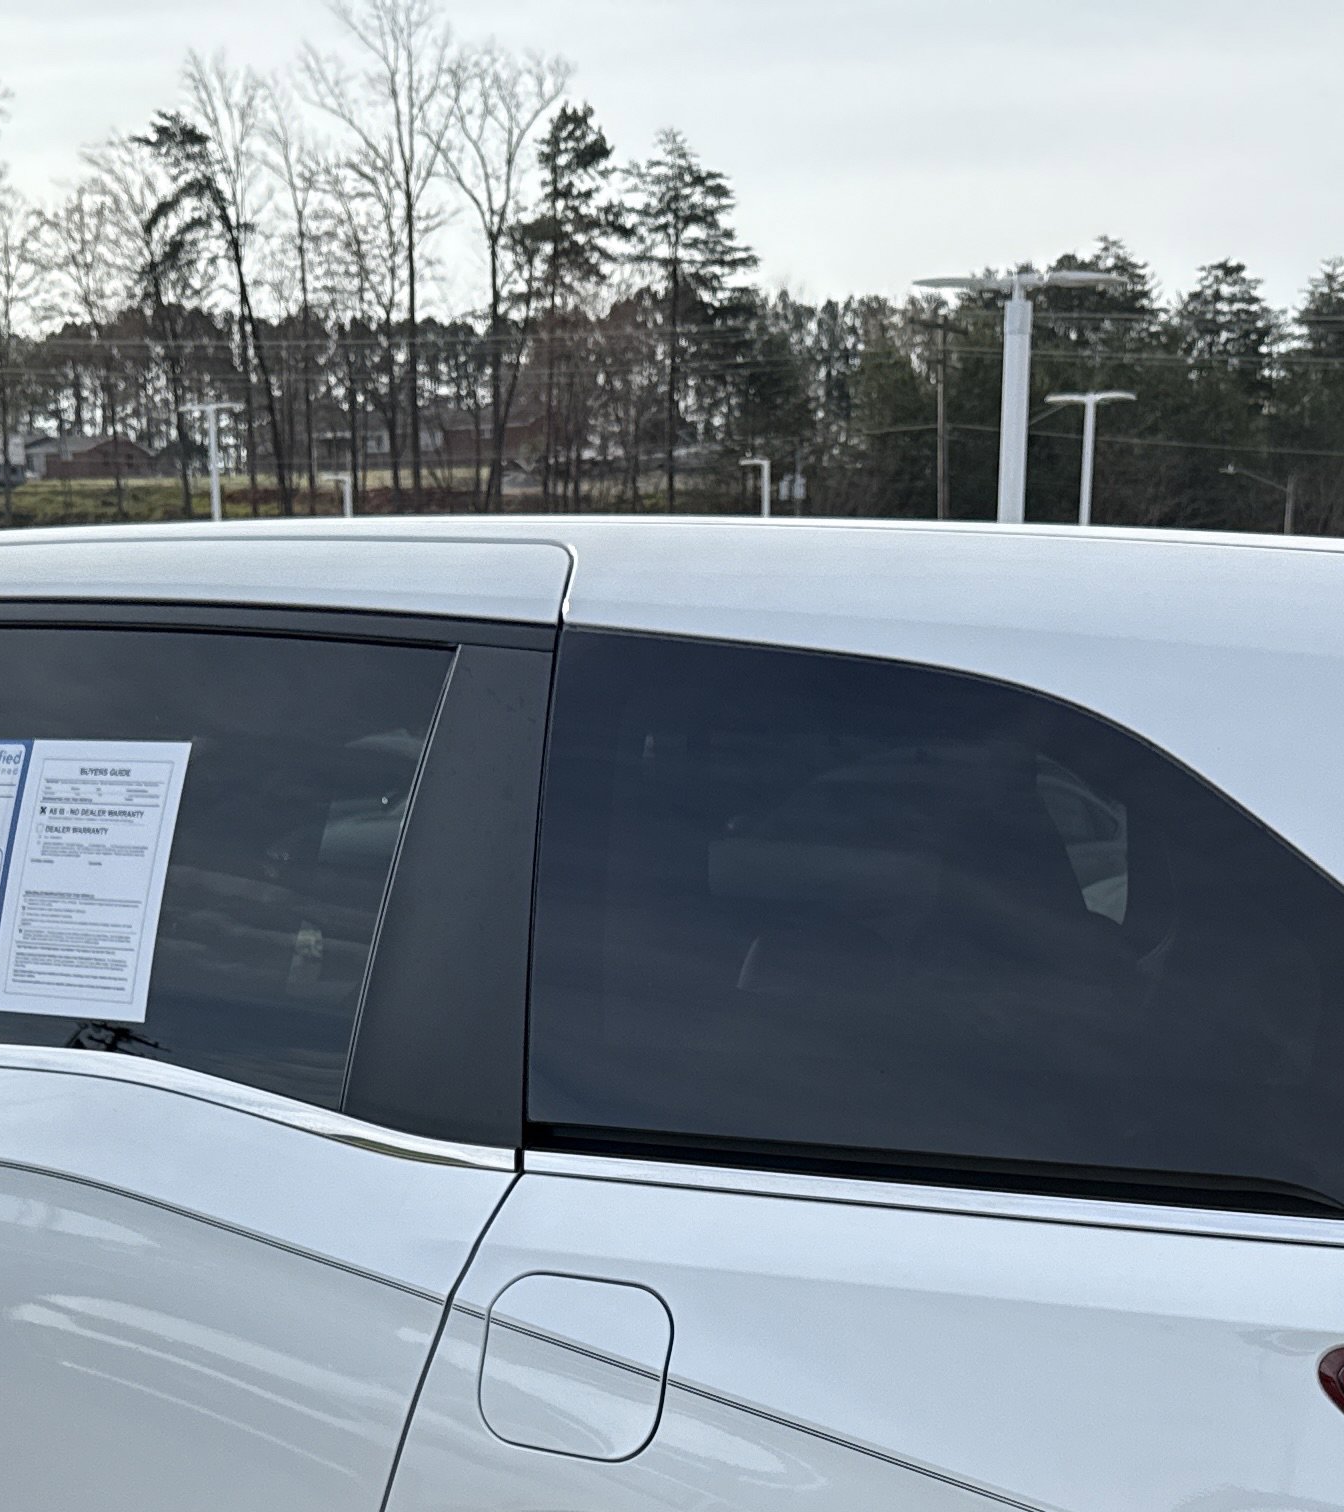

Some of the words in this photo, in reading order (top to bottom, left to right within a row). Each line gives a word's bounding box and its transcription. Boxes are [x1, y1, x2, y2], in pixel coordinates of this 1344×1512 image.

[81, 808, 107, 817] DEALER
[108, 810, 144, 818] WARRANTY
[45, 825, 71, 833] DEALER
[72, 827, 109, 835] WARRANTY
